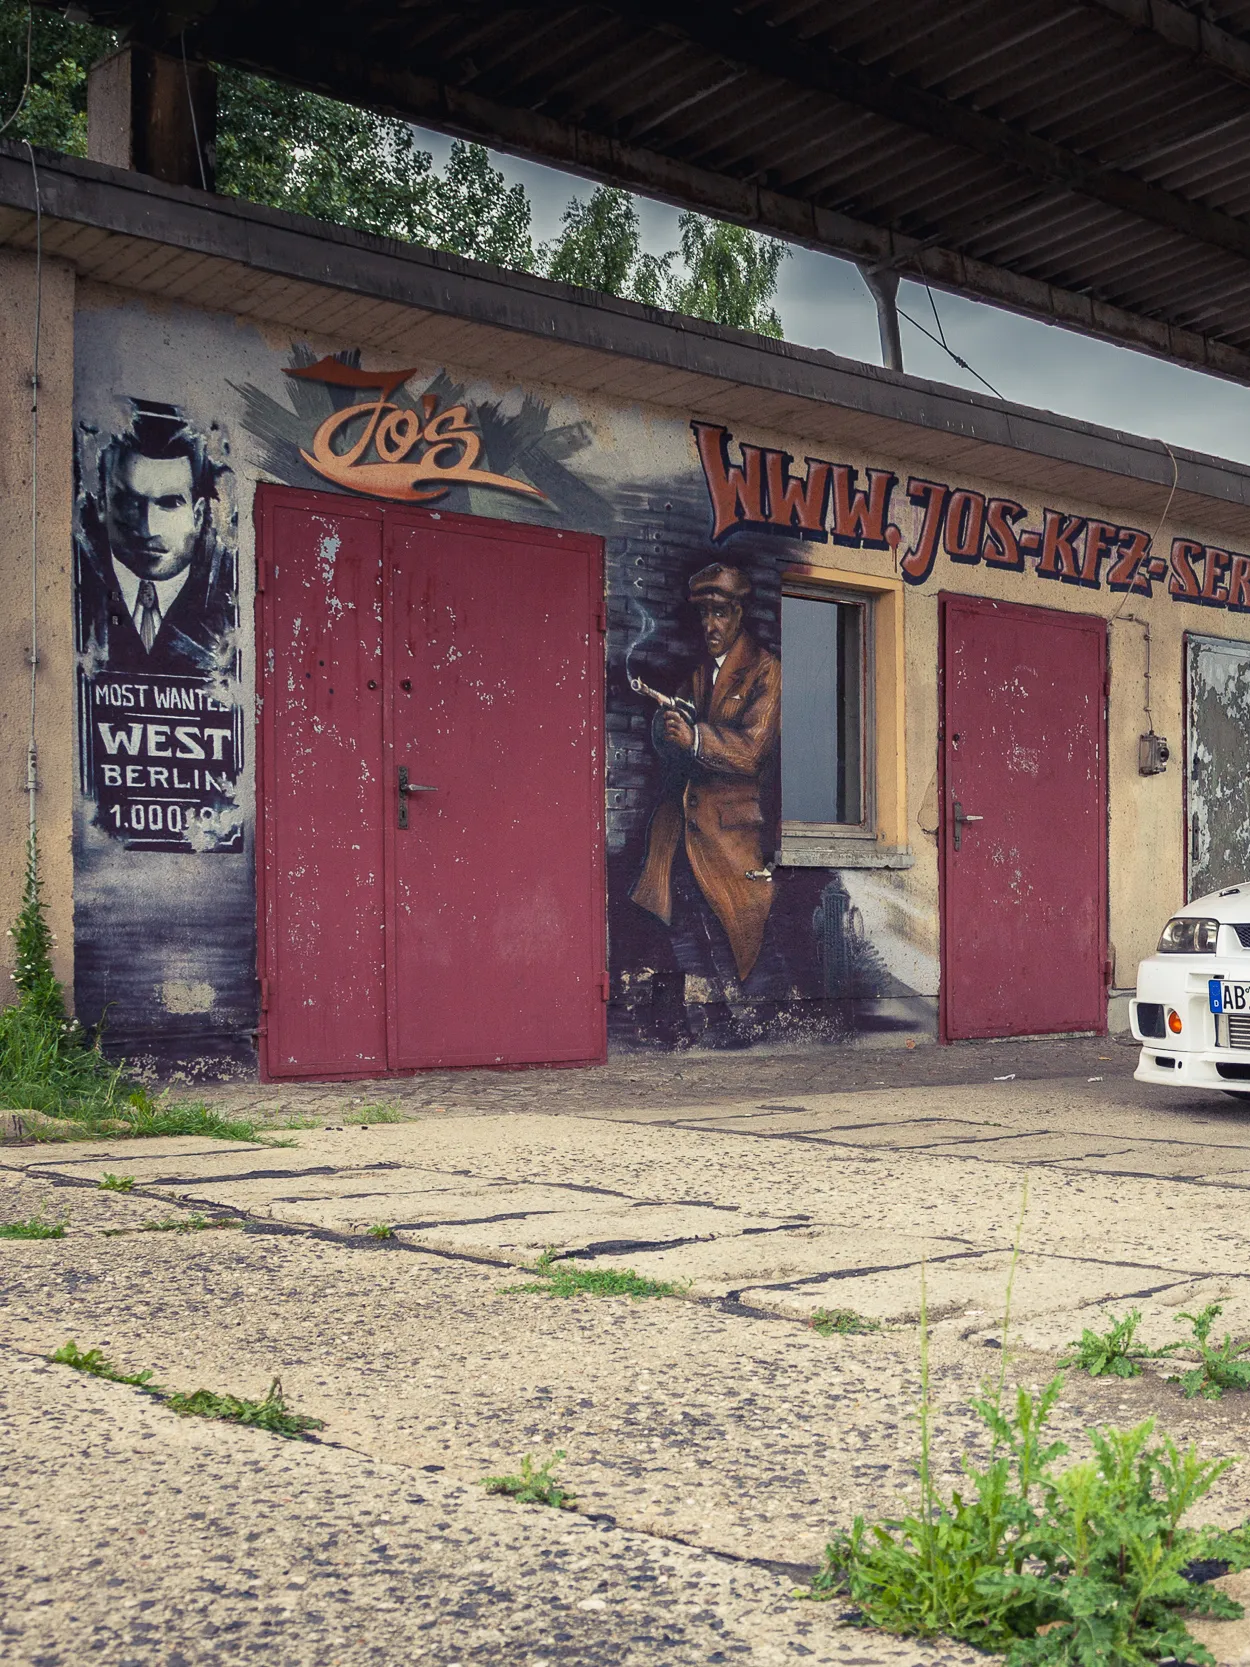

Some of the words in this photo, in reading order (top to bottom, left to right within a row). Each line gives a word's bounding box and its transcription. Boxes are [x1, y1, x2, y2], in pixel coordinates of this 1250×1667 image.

[282, 356, 548, 500] Jo's
[95, 684, 149, 707] MOST
[153, 686, 230, 712] WANTE
[97, 723, 231, 760] WEST
[101, 764, 228, 793] BERLIN
